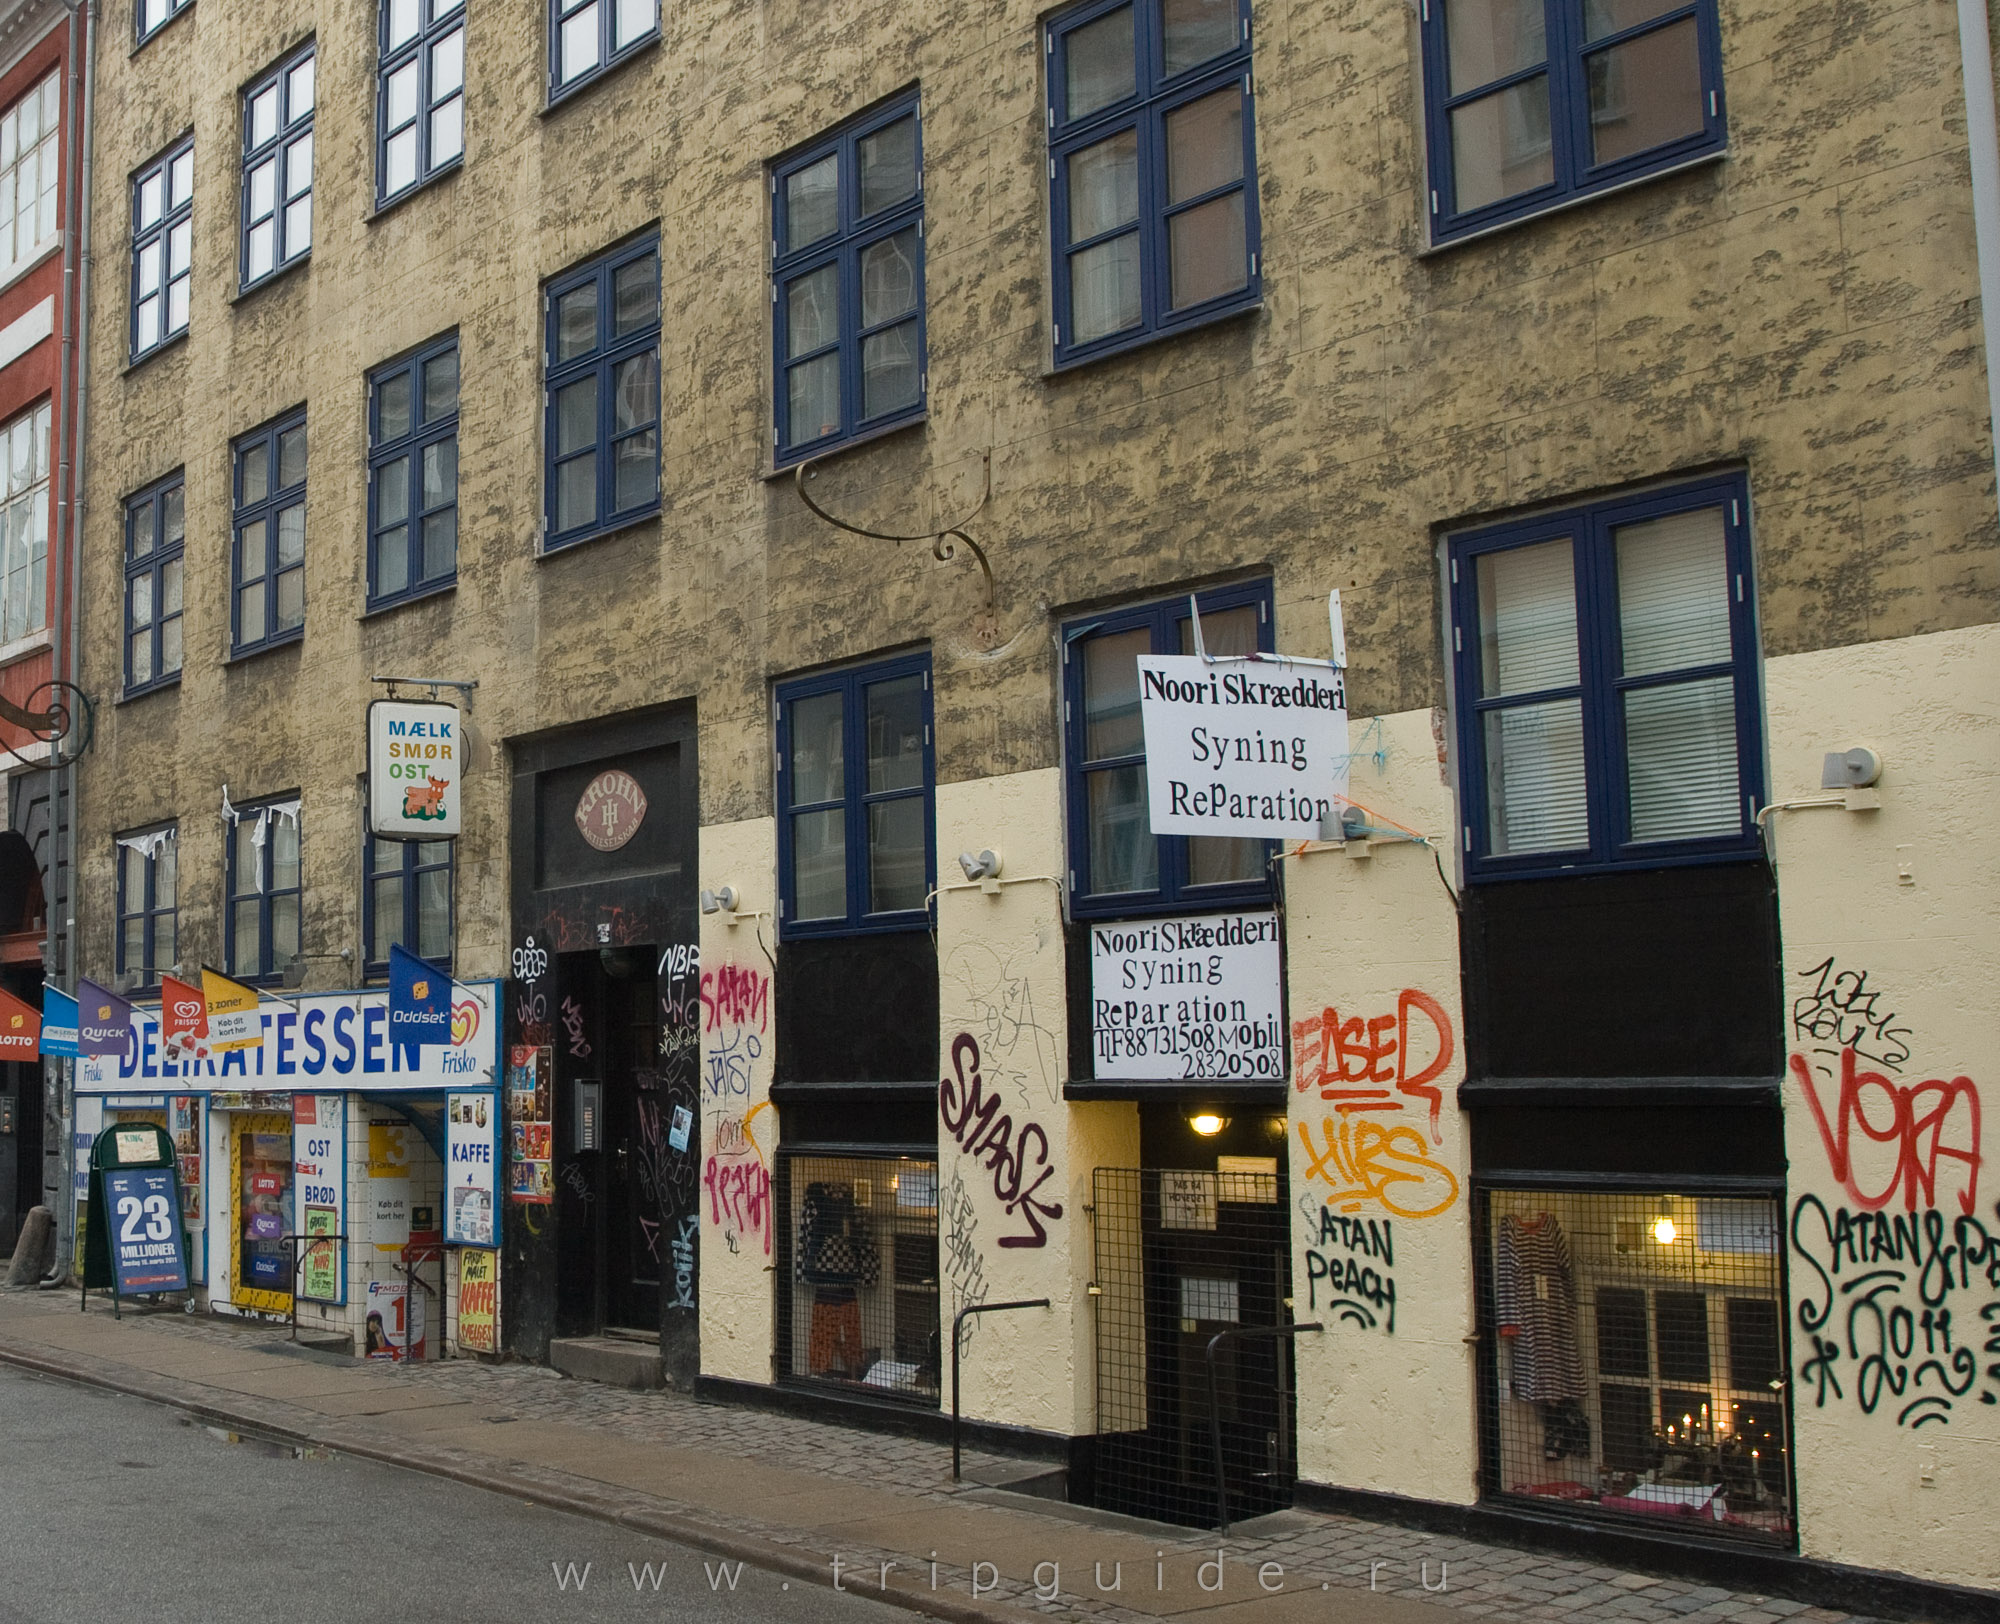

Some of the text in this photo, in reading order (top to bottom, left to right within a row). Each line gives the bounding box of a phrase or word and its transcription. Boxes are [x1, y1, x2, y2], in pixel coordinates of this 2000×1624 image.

[1142, 669, 1347, 712] Noori Skrædderi
[388, 721, 452, 738] MÆLK
[388, 743, 452, 760] SMØR
[1191, 727, 1308, 771] Syning
[389, 763, 430, 780] OST
[1094, 916, 1278, 957] Noori Skrædderi
[1122, 955, 1224, 991] Syning
[215, 998, 243, 1010] zoner
[174, 1018, 200, 1027] FRISKO
[218, 1017, 244, 1028] Køb dit
[393, 1009, 446, 1025] Oddset
[219, 1026, 248, 1037] kort her
[443, 1049, 477, 1074] Frisko
[1181, 1048, 1280, 1079] 28320508
[308, 1139, 331, 1158] OST
[452, 1142, 490, 1164] KAFFE
[258, 1178, 275, 1189] LOTTO
[305, 1185, 336, 1204] BRØD
[378, 1201, 392, 1209] Køb
[117, 1194, 172, 1243] 23
[377, 1211, 405, 1220] kort her
[120, 1243, 176, 1259] MILLIONER
[460, 1281, 494, 1315] KAFFE
[391, 1296, 405, 1332] 1
